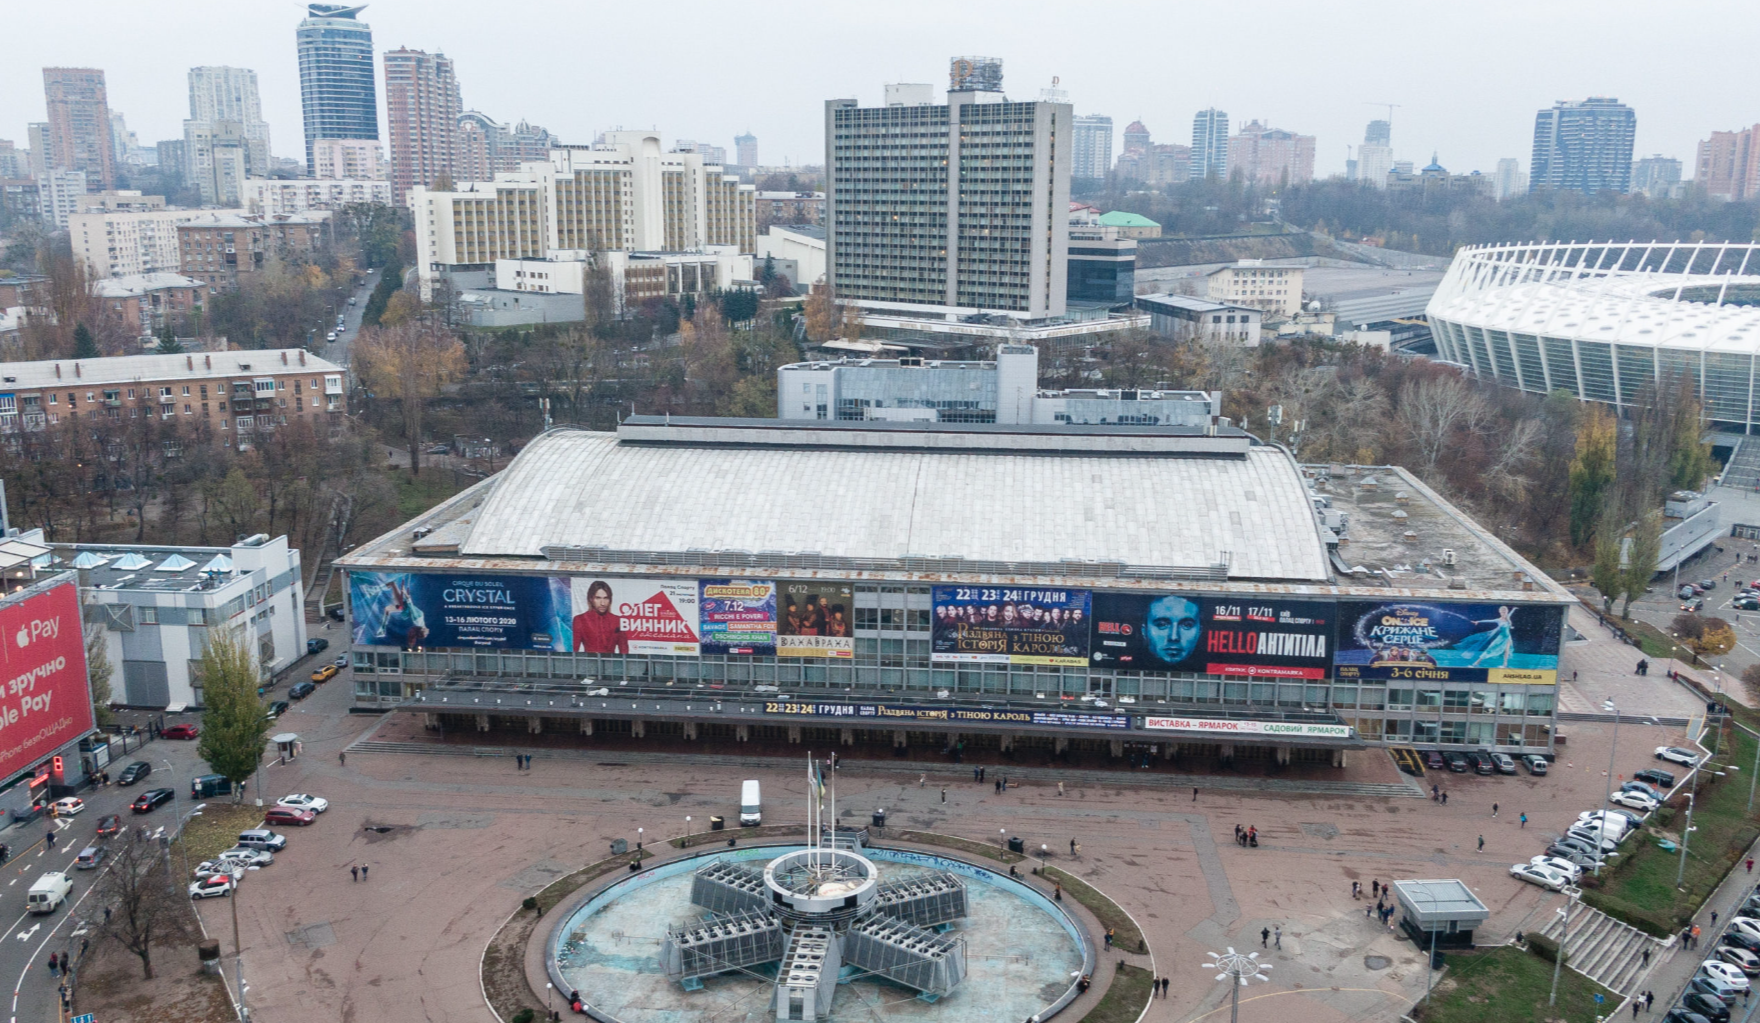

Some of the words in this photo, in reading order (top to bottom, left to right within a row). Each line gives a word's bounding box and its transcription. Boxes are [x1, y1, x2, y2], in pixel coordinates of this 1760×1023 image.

[707, 587, 751, 595] ДИСКОТЕКА
[788, 584, 808, 593] 6/12
[442, 588, 516, 604] CRYSTAL
[956, 588, 971, 600] 22
[981, 589, 996, 601] 23
[1002, 589, 1018, 602] 24
[1023, 590, 1067, 604] ГРУДНЯ
[619, 603, 662, 617] ОЛЕГ
[724, 601, 745, 611] 7.12
[1214, 605, 1241, 616] 16/11
[1248, 606, 1273, 617] 17/11
[1396, 608, 1419, 617] Disney
[466, 616, 498, 624] ЛЮТОГО
[498, 617, 517, 625] 2020
[619, 617, 689, 634] ВИННИК
[1382, 616, 1398, 626] ON
[1409, 617, 1429, 627] ICE
[31, 616, 59, 642] Pay
[957, 622, 1008, 640] РІЗДВЯНА
[1369, 625, 1439, 639] КРИЖАНЕ
[1020, 632, 1065, 643] ТІНОЮ
[1383, 634, 1425, 645] СЕРЦЕ
[957, 639, 1008, 653] ІСТОРІЯ
[1012, 643, 1064, 654] КАРОЛЬ
[8, 656, 66, 696] зручно
[1390, 667, 1413, 678] 3-6
[1414, 668, 1449, 679] січня
[21, 690, 52, 717] Pay
[765, 702, 779, 713] 22
[784, 703, 798, 714] 23
[800, 704, 813, 714] 24
[818, 705, 854, 716] ГРУДНЯ
[877, 705, 915, 717] РІЗДВЯНА
[916, 708, 948, 720] ІСТОРІЯ
[956, 710, 991, 720] ТІНОЮ
[993, 712, 1031, 721] КАРОЛЬ
[1148, 718, 1191, 728] ВИСТАВКА
[1198, 721, 1239, 731] ЯРМАРОК
[1263, 723, 1303, 733] САДОВИЙ
[1306, 726, 1346, 735] ЯРМАРОК
